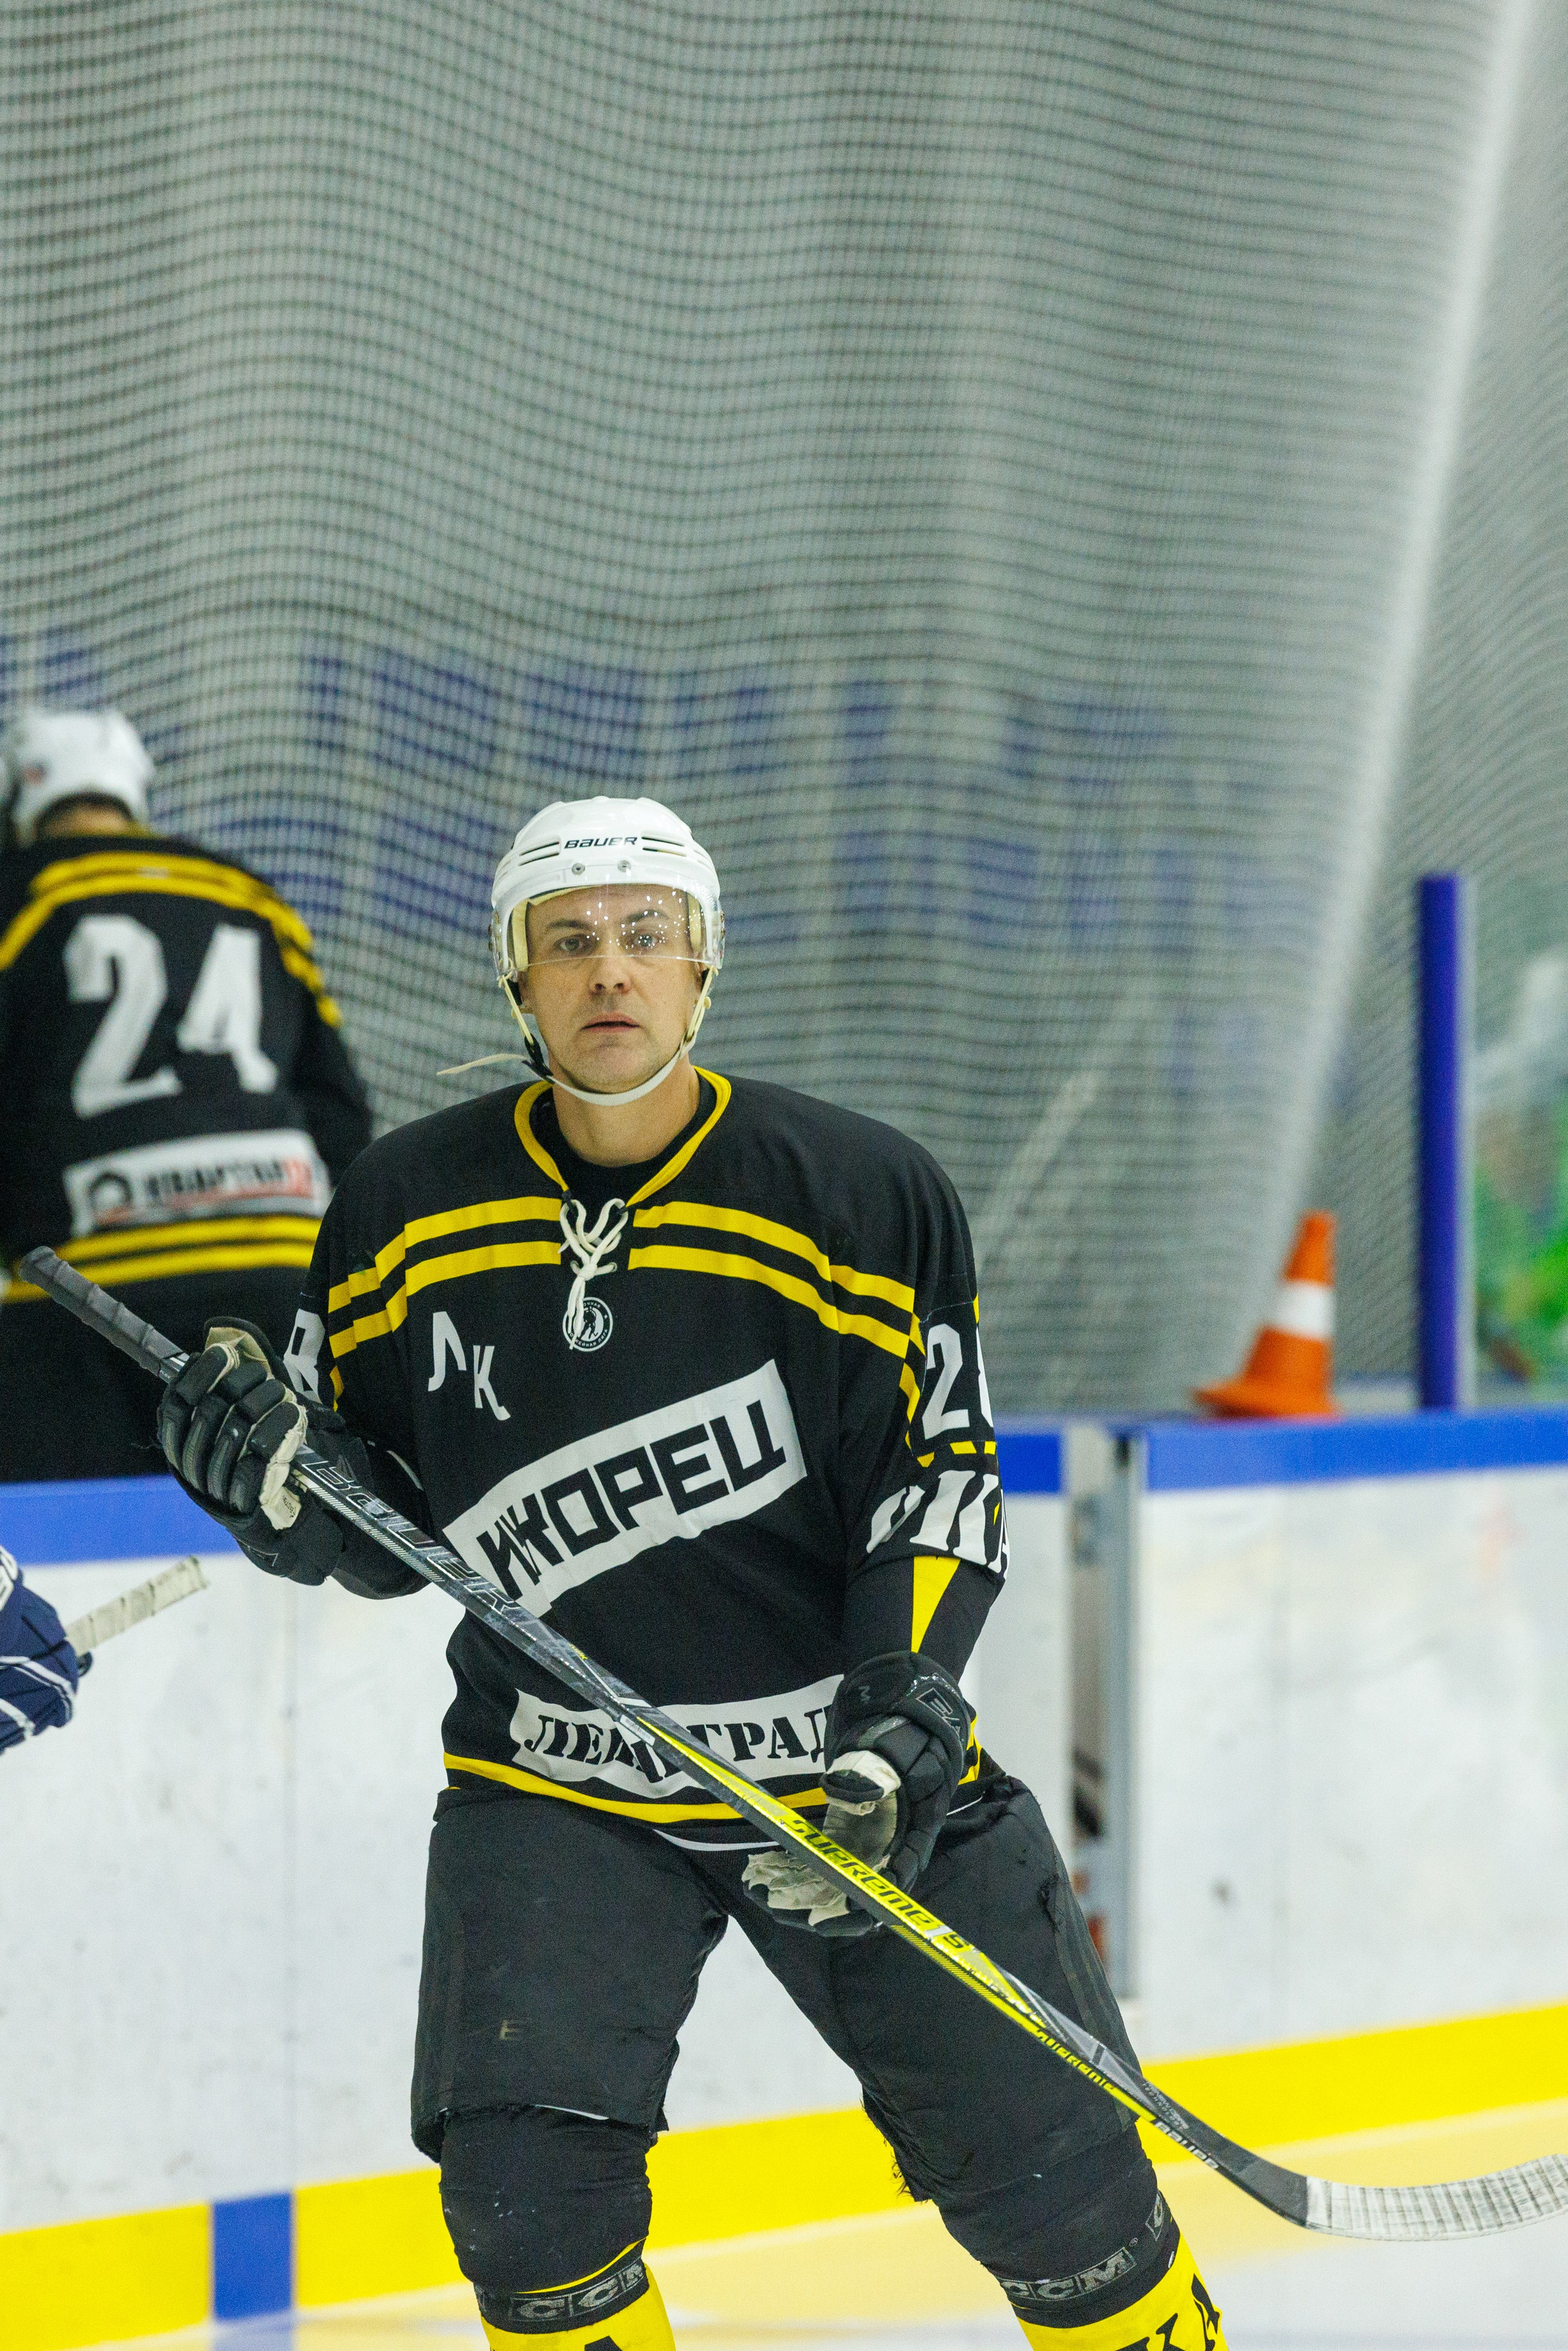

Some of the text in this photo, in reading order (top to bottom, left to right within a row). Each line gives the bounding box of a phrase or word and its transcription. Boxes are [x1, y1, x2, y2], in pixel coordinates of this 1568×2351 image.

[564, 836, 638, 850] BAUER
[63, 913, 279, 1118] 24
[922, 1323, 993, 1440] 2
[524, 1704, 832, 1783] ЛЕГРА
[1000, 2251, 1131, 2300] CCM
